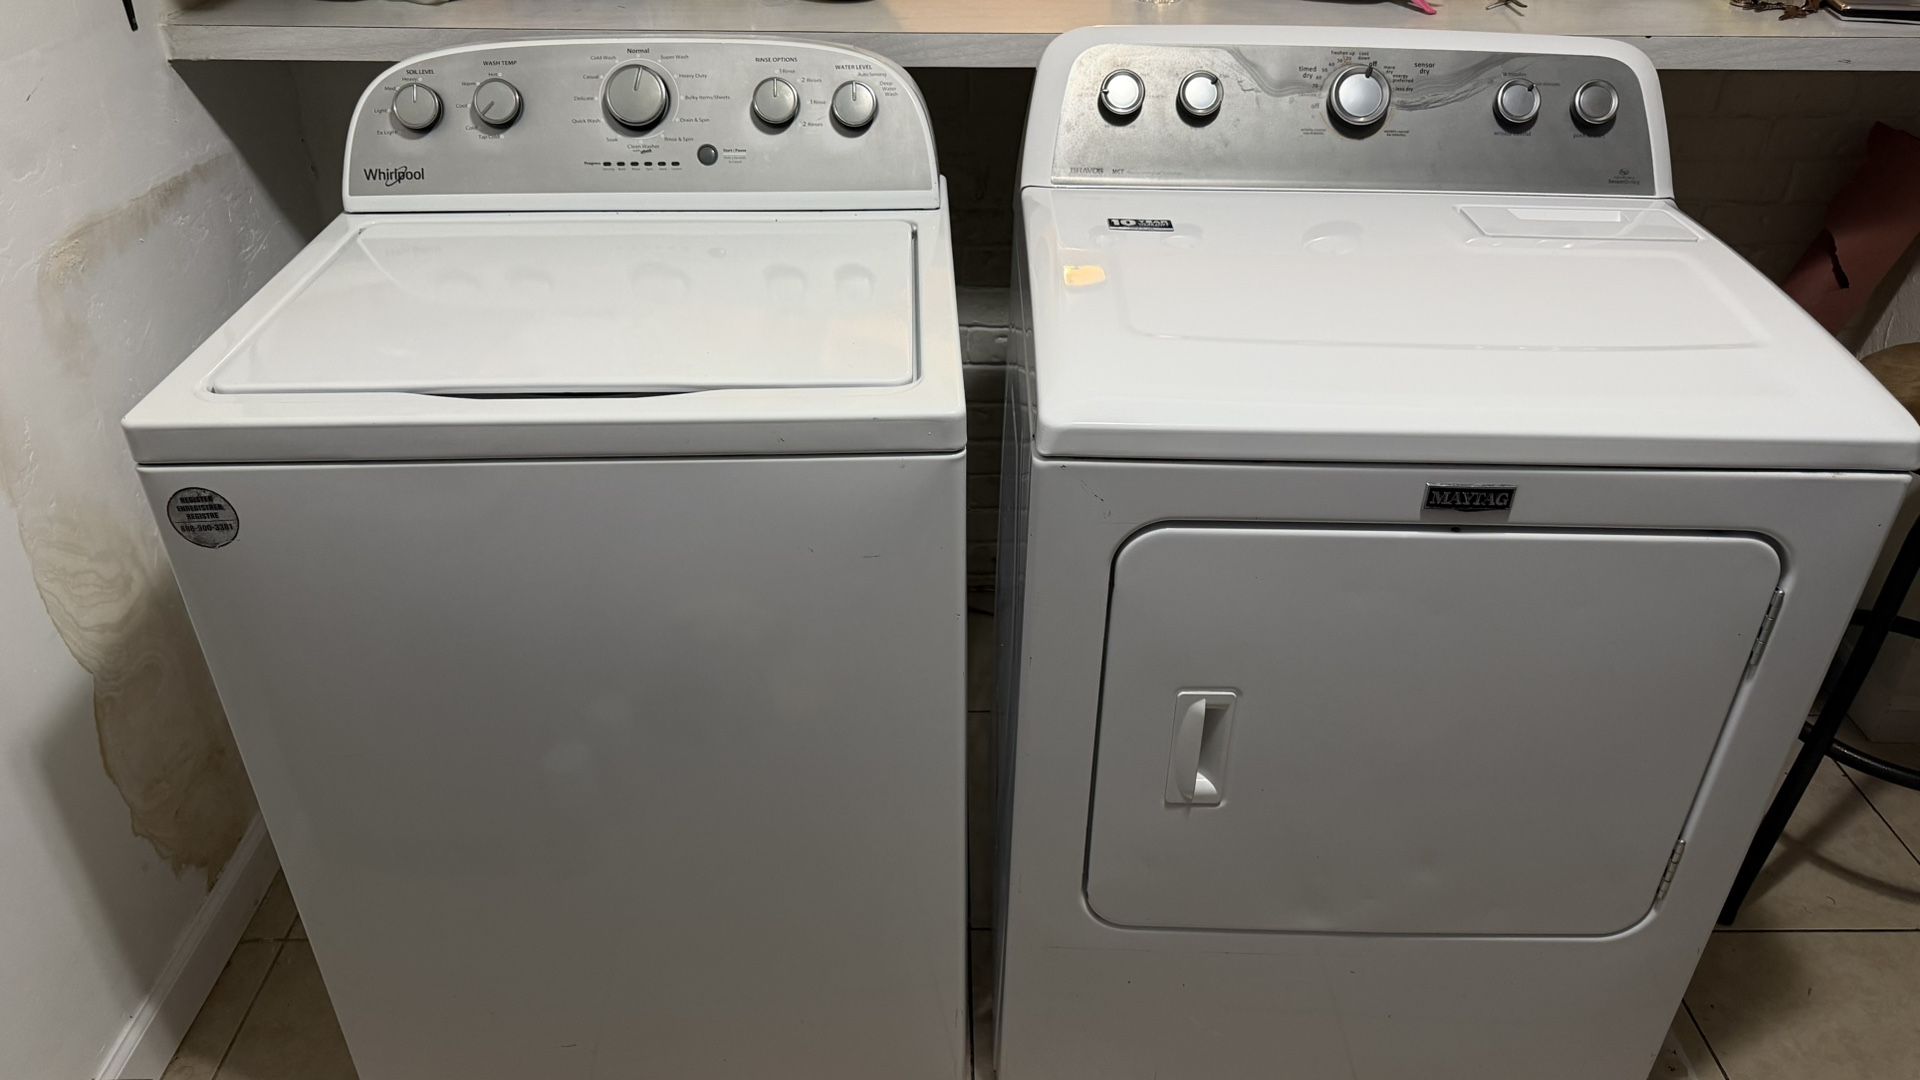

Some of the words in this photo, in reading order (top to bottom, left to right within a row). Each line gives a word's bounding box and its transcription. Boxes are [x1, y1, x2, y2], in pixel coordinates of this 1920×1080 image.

[362, 166, 425, 187] Whirlpool
[1111, 219, 1136, 227] 10
[1430, 490, 1510, 506] MAYTAG
[186, 512, 220, 520] REGISTRE
